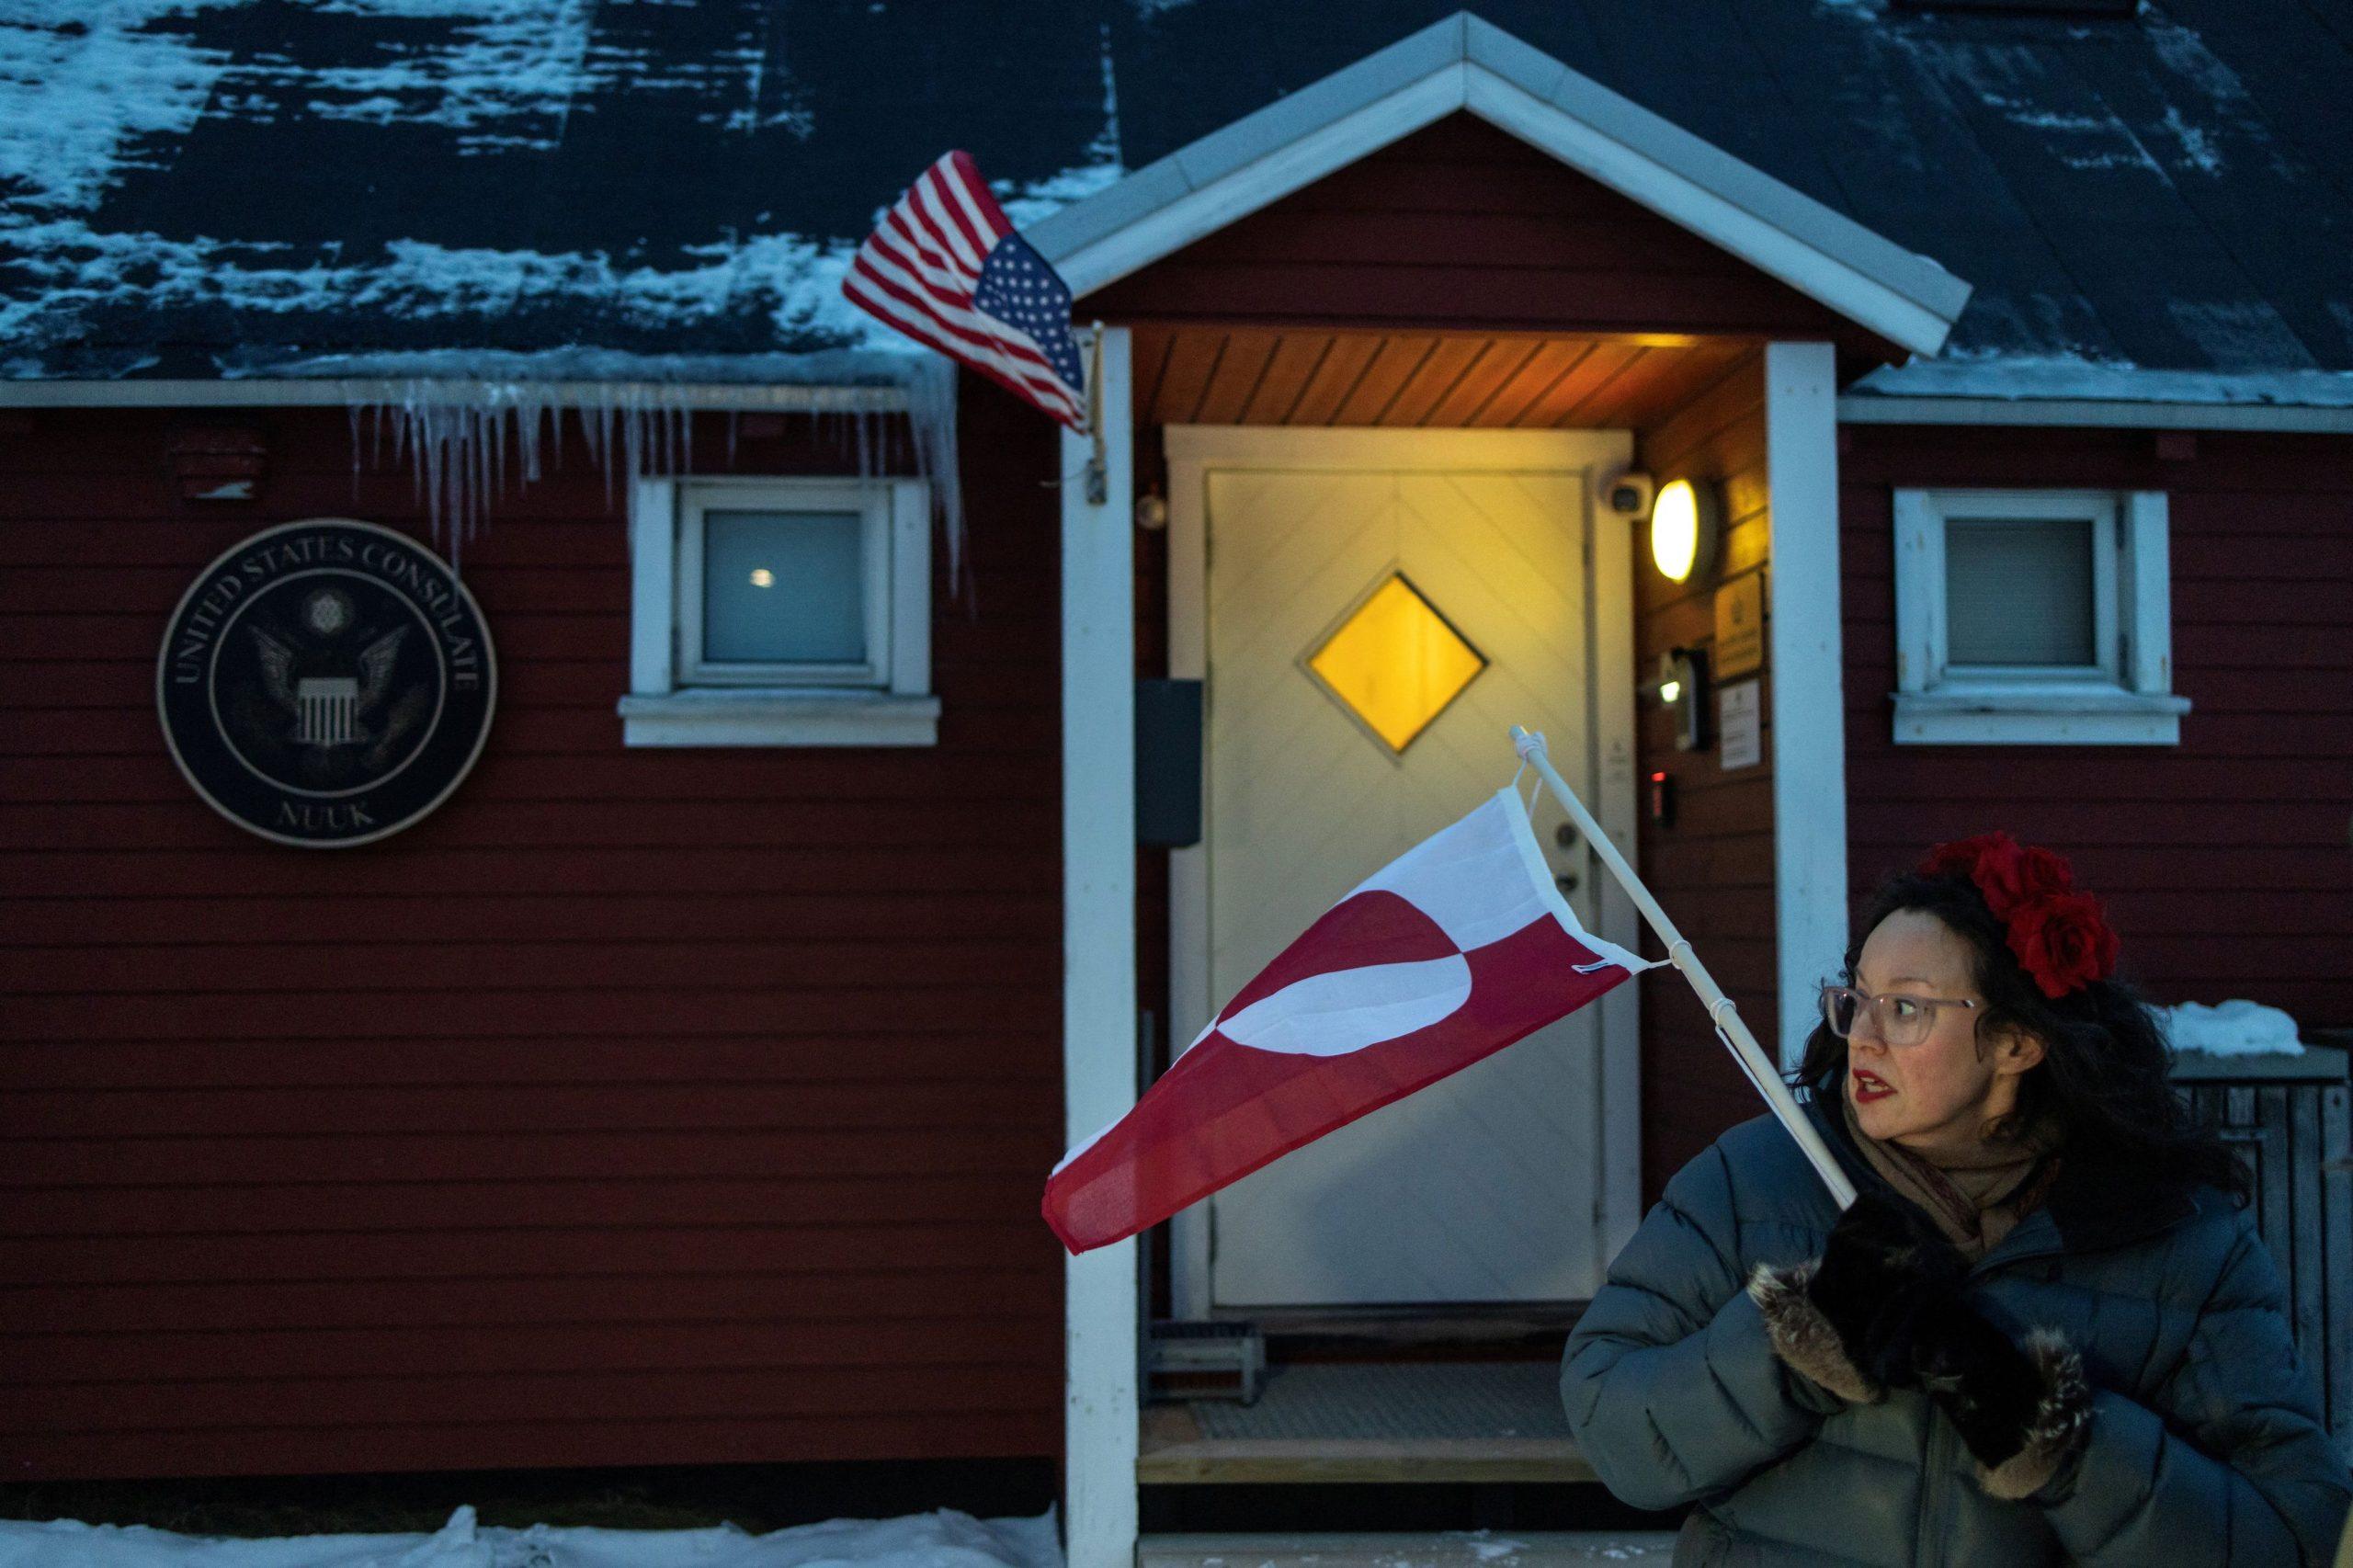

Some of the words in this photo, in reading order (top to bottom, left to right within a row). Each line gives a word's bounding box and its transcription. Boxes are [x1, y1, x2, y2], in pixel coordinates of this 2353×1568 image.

[176, 574, 243, 684] UNITED
[244, 538, 354, 581] STATES
[362, 543, 479, 691] CONSULATE
[279, 801, 374, 828] NUUK
